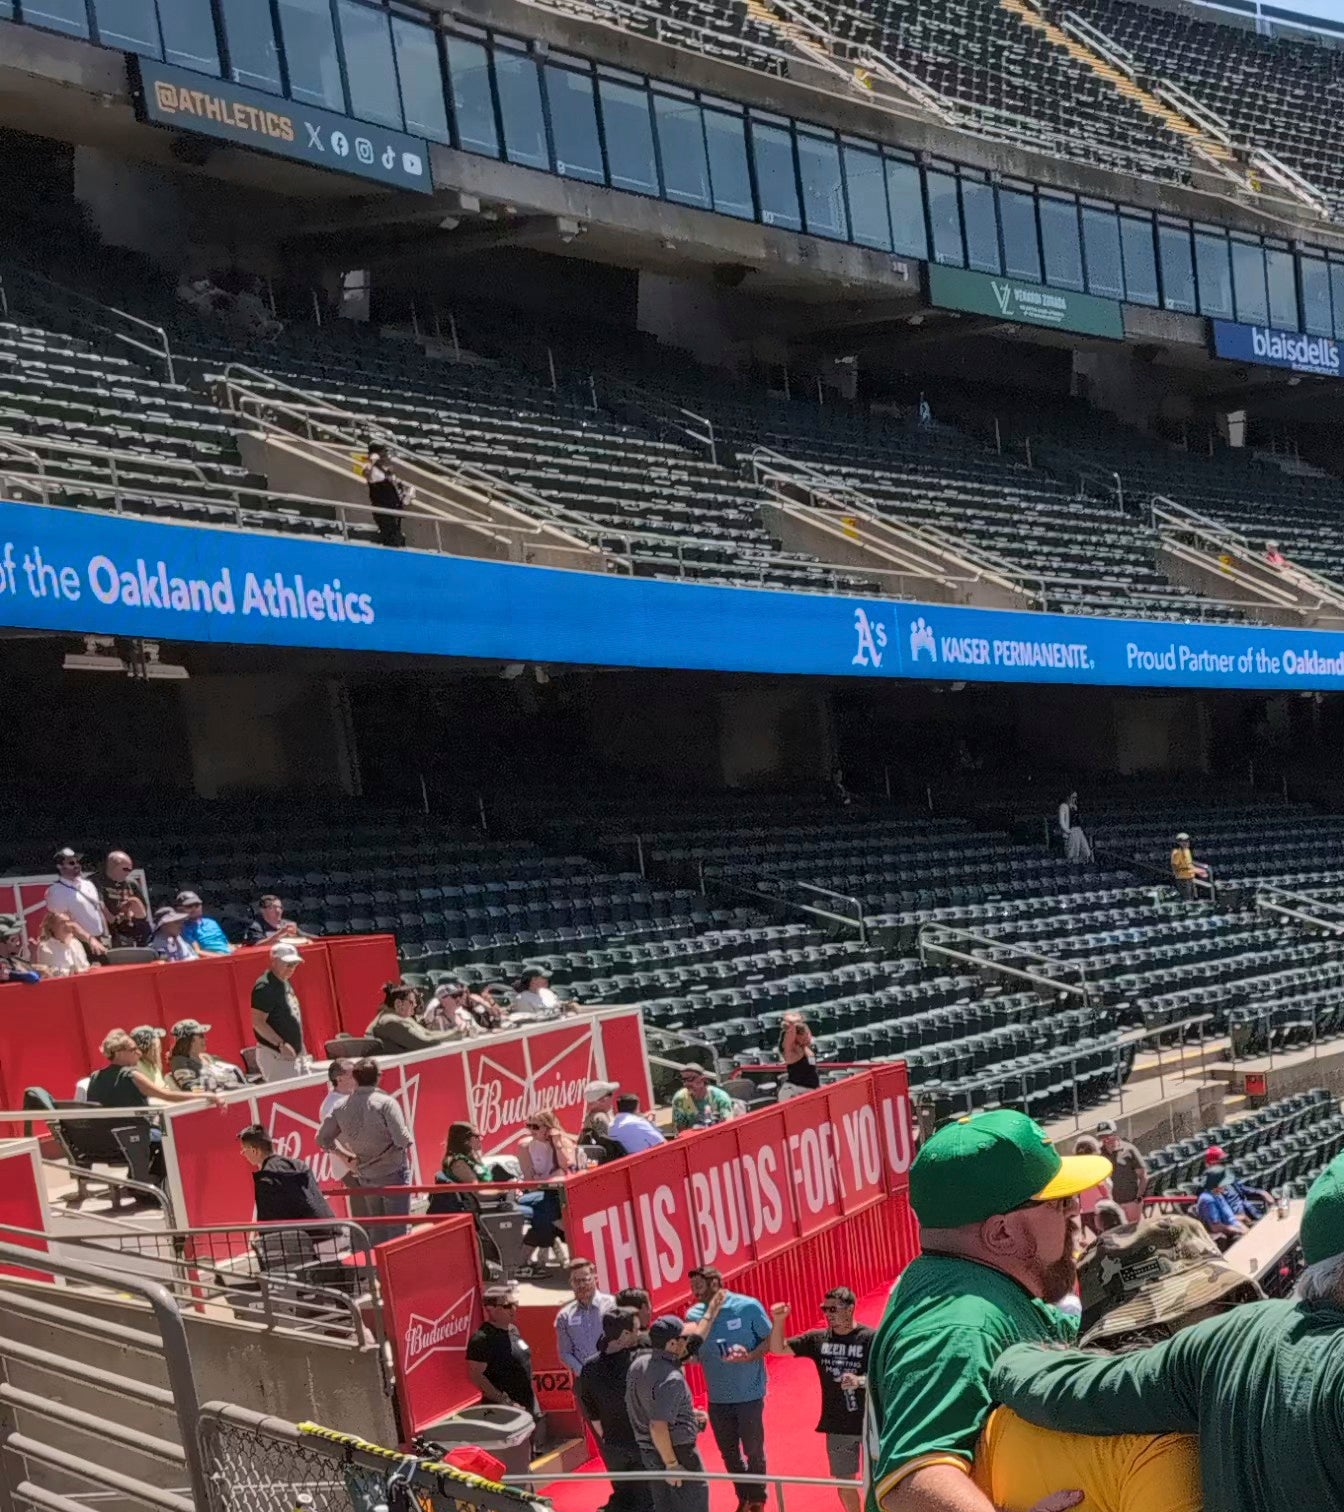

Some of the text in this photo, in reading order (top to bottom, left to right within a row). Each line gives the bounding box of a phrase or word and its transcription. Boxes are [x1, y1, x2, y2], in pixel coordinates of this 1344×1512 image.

[154, 80, 295, 142] @ATHLETICS
[23, 546, 81, 601] the
[88, 555, 235, 615] Oakland
[242, 571, 375, 625] Athletics
[941, 636, 990, 665] KAISER
[1126, 643, 1176, 670] Proud
[1179, 645, 1234, 673] Partner
[1238, 647, 1255, 674] of
[1256, 648, 1280, 674] the
[1282, 649, 1344, 676] Oakland
[472, 1072, 588, 1137] Budweiser
[582, 1095, 912, 1298] THIS BUDS FOR YOU
[405, 1314, 471, 1356] Budweiser
[533, 1373, 570, 1393] 102
